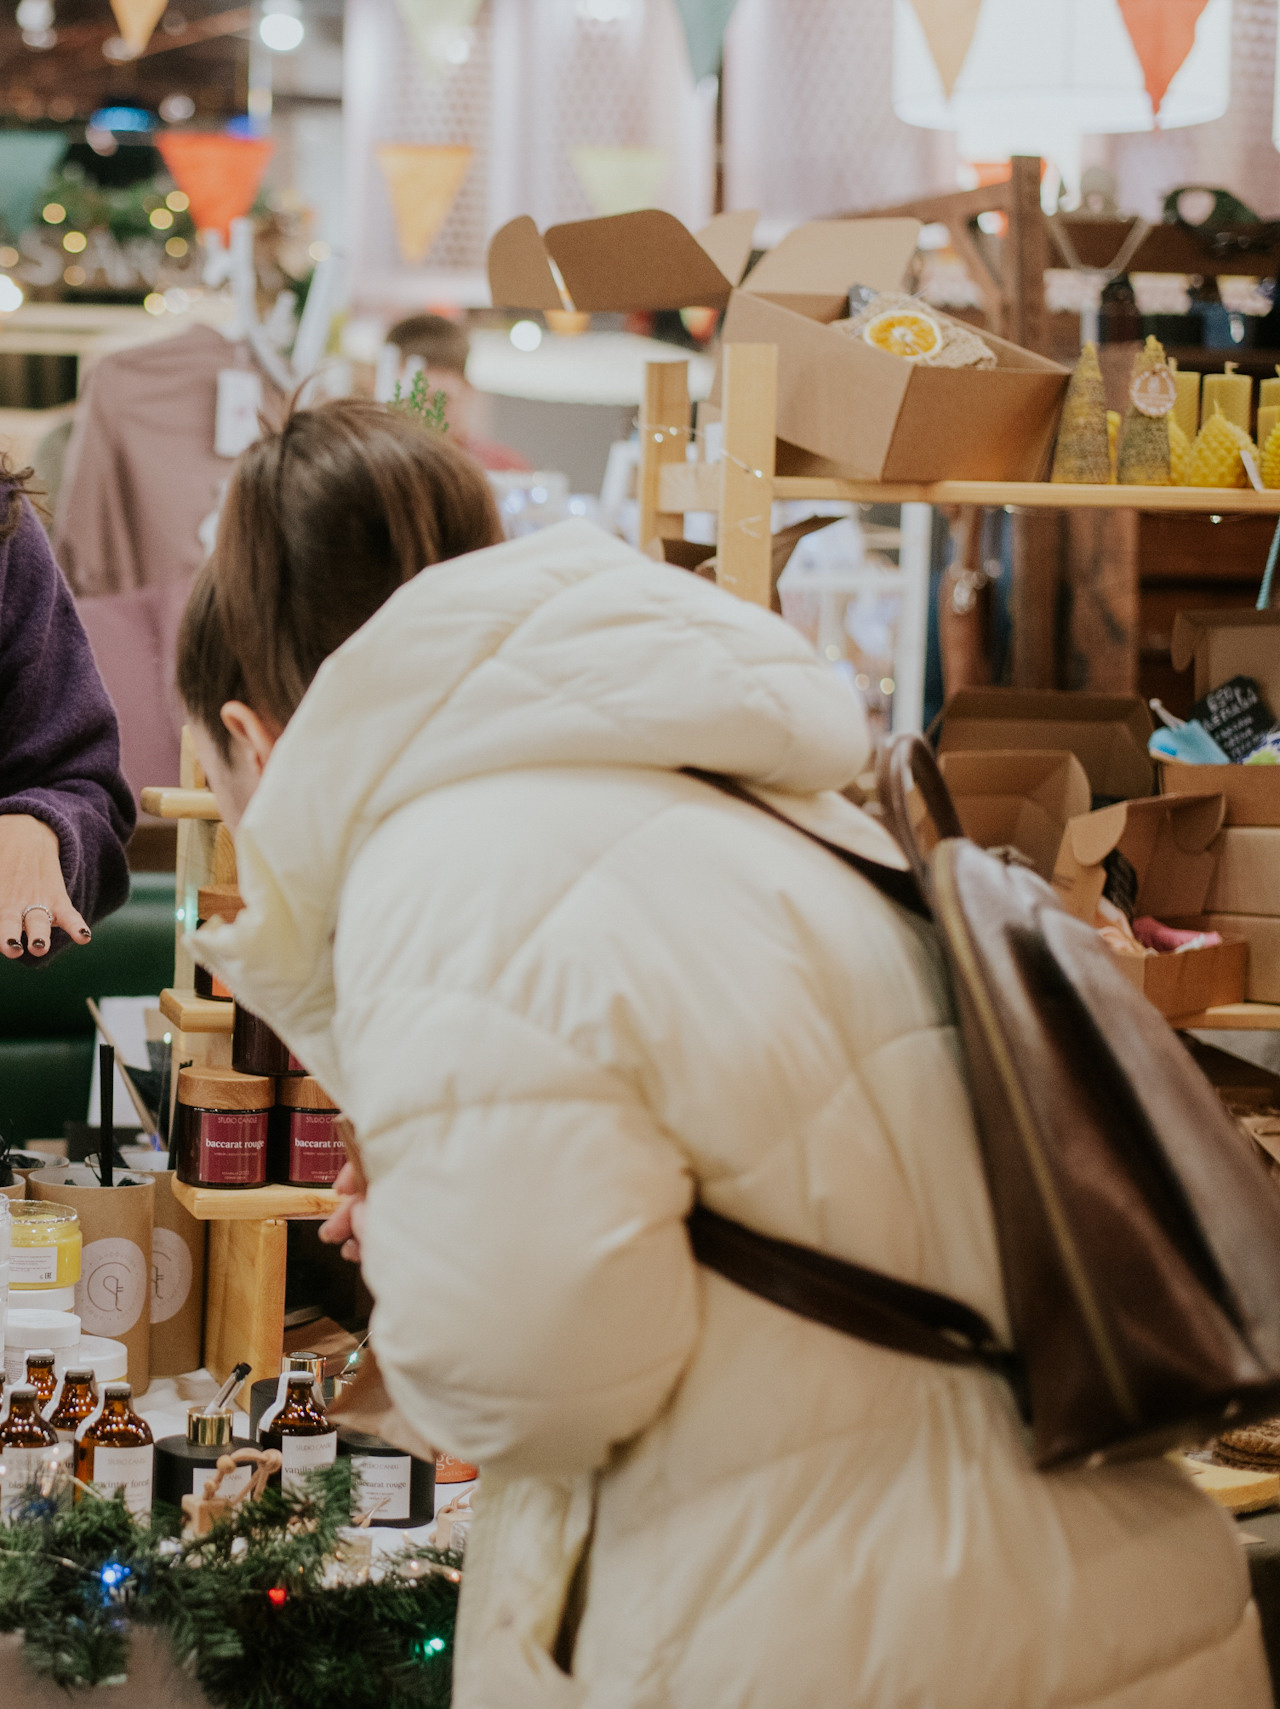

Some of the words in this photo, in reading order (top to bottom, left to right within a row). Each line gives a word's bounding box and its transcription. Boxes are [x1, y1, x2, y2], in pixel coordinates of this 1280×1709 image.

[205, 1138, 242, 1149] baccarat
[244, 1140, 265, 1150] rouge
[294, 1137, 331, 1148] baccarat
[386, 1482, 406, 1490] rouge
